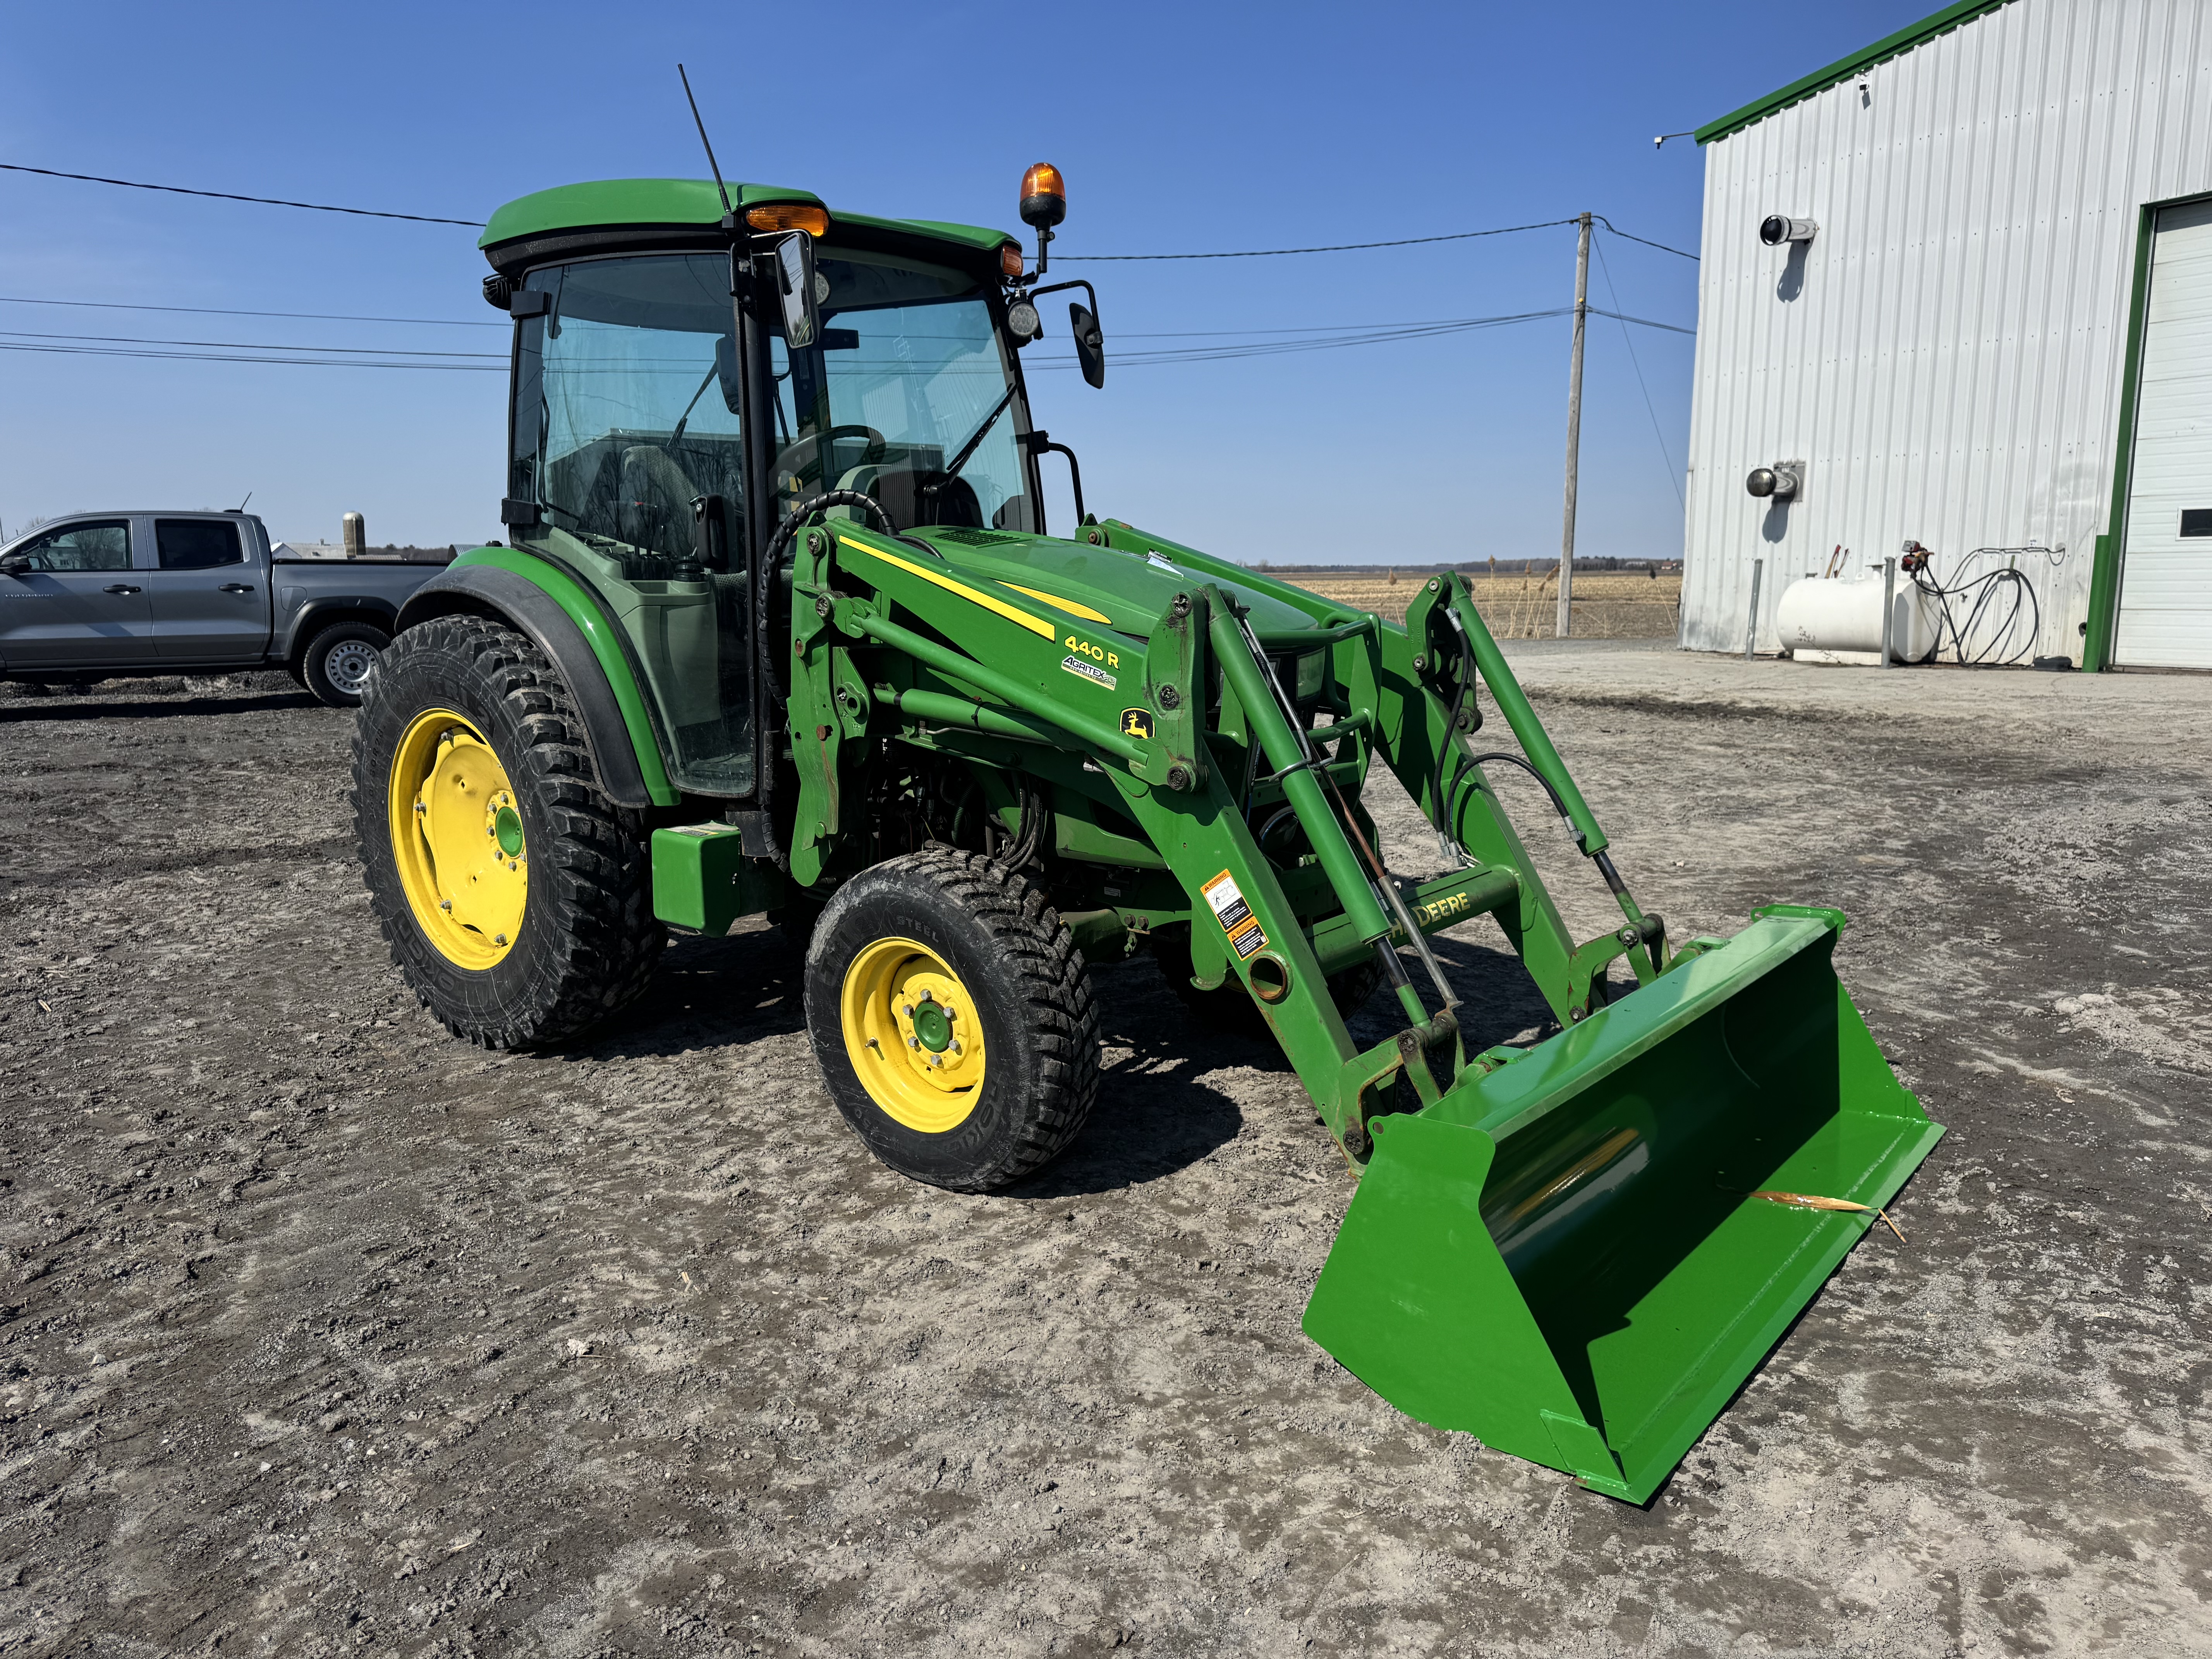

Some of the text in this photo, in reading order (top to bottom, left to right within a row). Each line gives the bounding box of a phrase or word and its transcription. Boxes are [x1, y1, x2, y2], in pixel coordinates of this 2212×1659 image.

[1065, 635, 1120, 671] 440 R
[1064, 657, 1104, 679] AGRITEX
[1208, 872, 1226, 888] WARNING
[1411, 892, 1470, 927] DEERE
[895, 914, 940, 943] STEEL
[1235, 920, 1255, 935] WARNING
